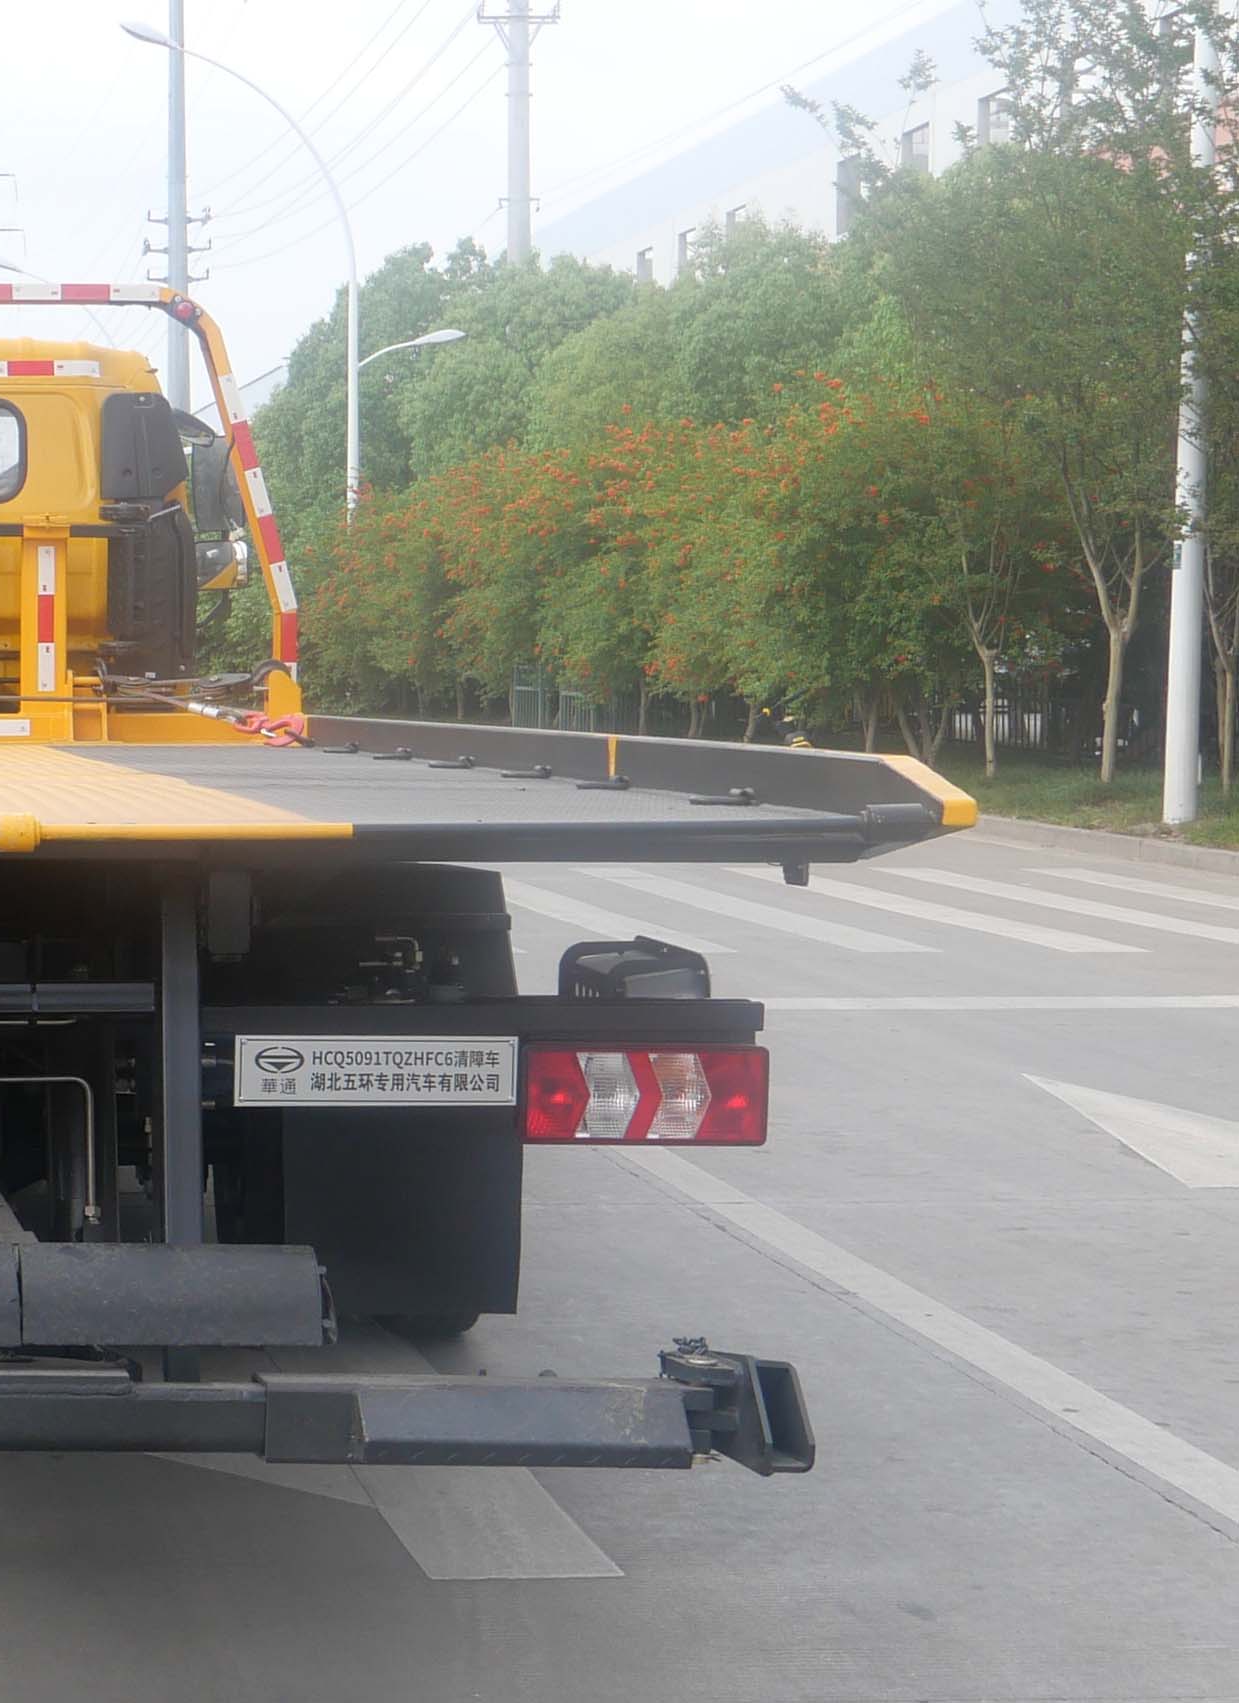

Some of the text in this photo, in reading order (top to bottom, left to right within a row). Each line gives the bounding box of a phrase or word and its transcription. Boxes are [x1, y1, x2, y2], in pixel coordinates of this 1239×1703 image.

[312, 1050, 500, 1069] HCQ5091TQZHFC6清障车
[310, 1072, 500, 1093] 湖北五环专用汽车有限公司
